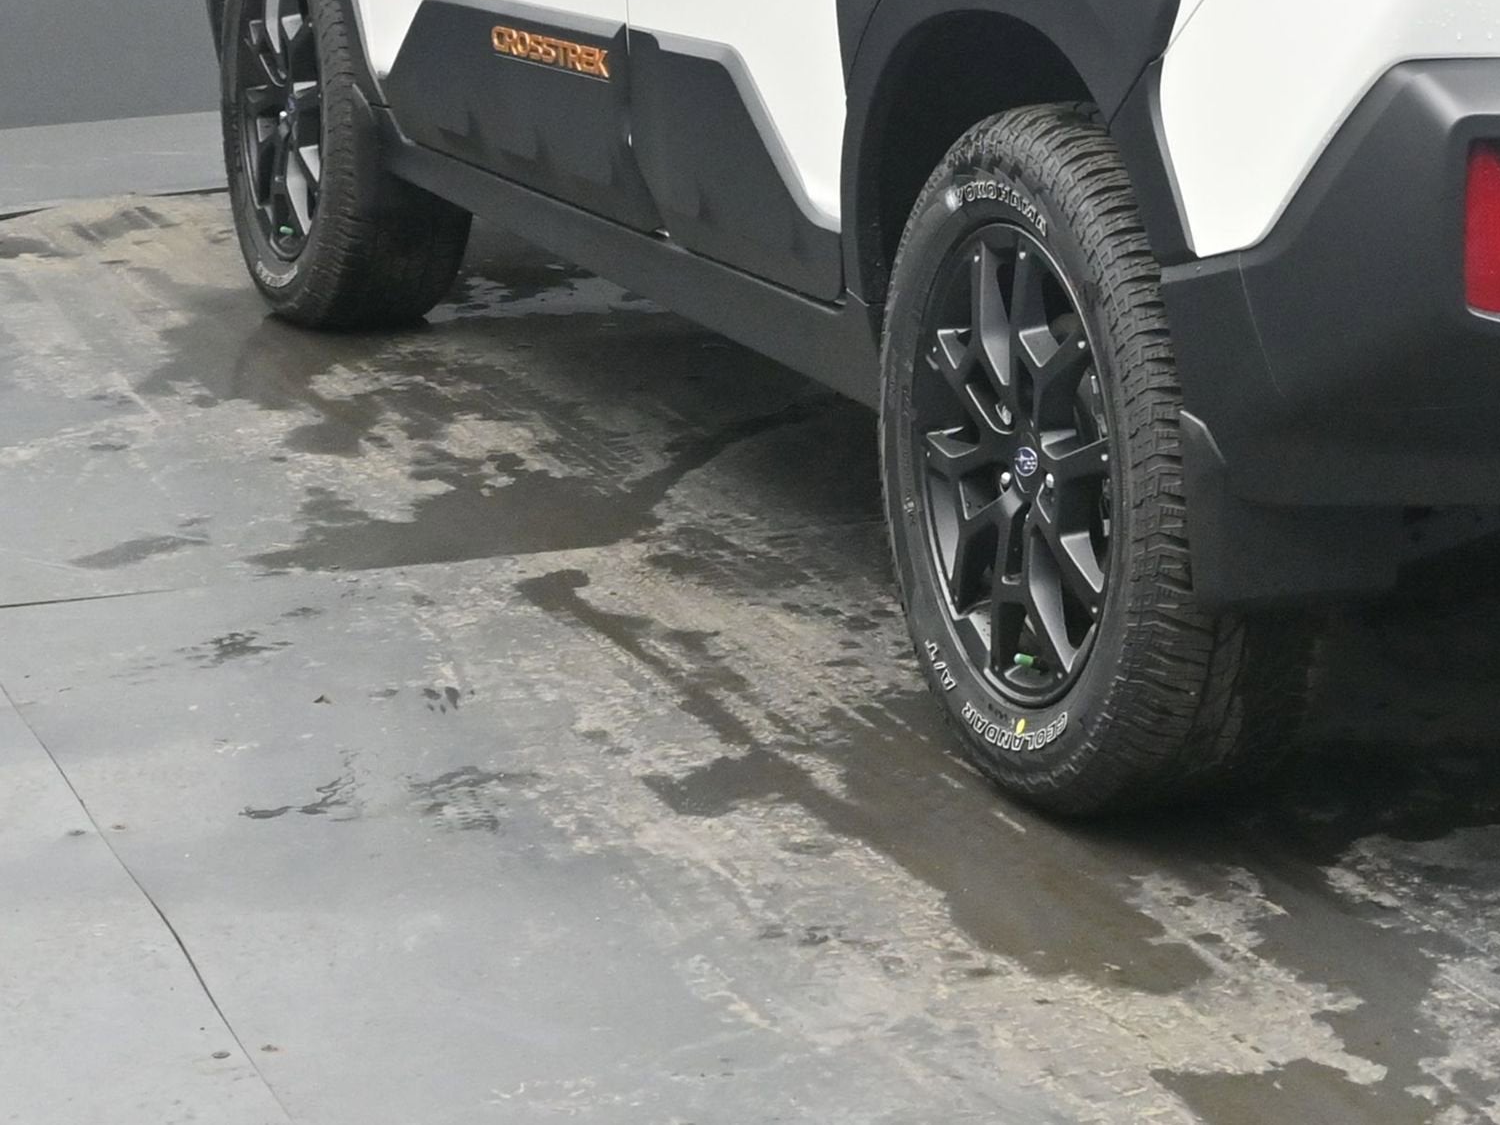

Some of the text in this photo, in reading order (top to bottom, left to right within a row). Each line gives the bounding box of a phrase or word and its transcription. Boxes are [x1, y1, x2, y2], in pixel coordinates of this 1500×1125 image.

[491, 25, 609, 78] CROSSTREK
[954, 180, 1047, 237] YOKOHAMA
[961, 701, 1068, 751] GEOLANDAR
